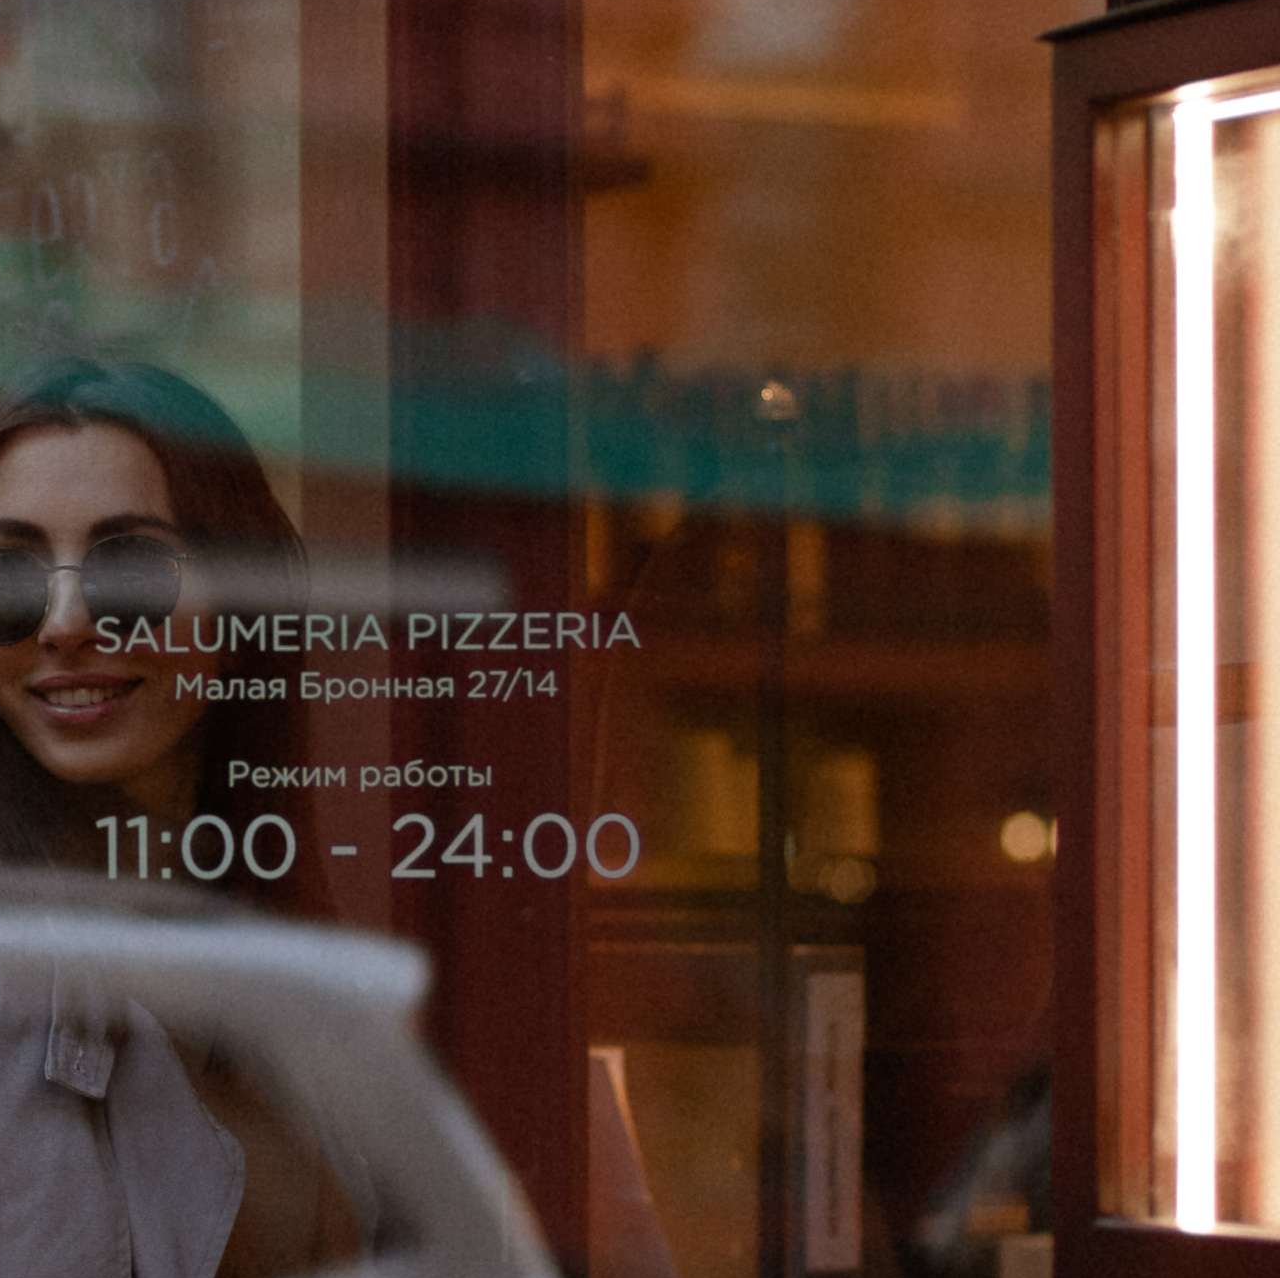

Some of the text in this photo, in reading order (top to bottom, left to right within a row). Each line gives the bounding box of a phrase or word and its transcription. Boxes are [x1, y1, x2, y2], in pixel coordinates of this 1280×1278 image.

[95, 612, 641, 654] SALUMERIA PIZZERIA
[175, 667, 558, 704] Малая Бронная 27/14
[229, 759, 492, 792] Режим работы
[95, 814, 296, 880] 11:00
[391, 812, 640, 879] 24:00
